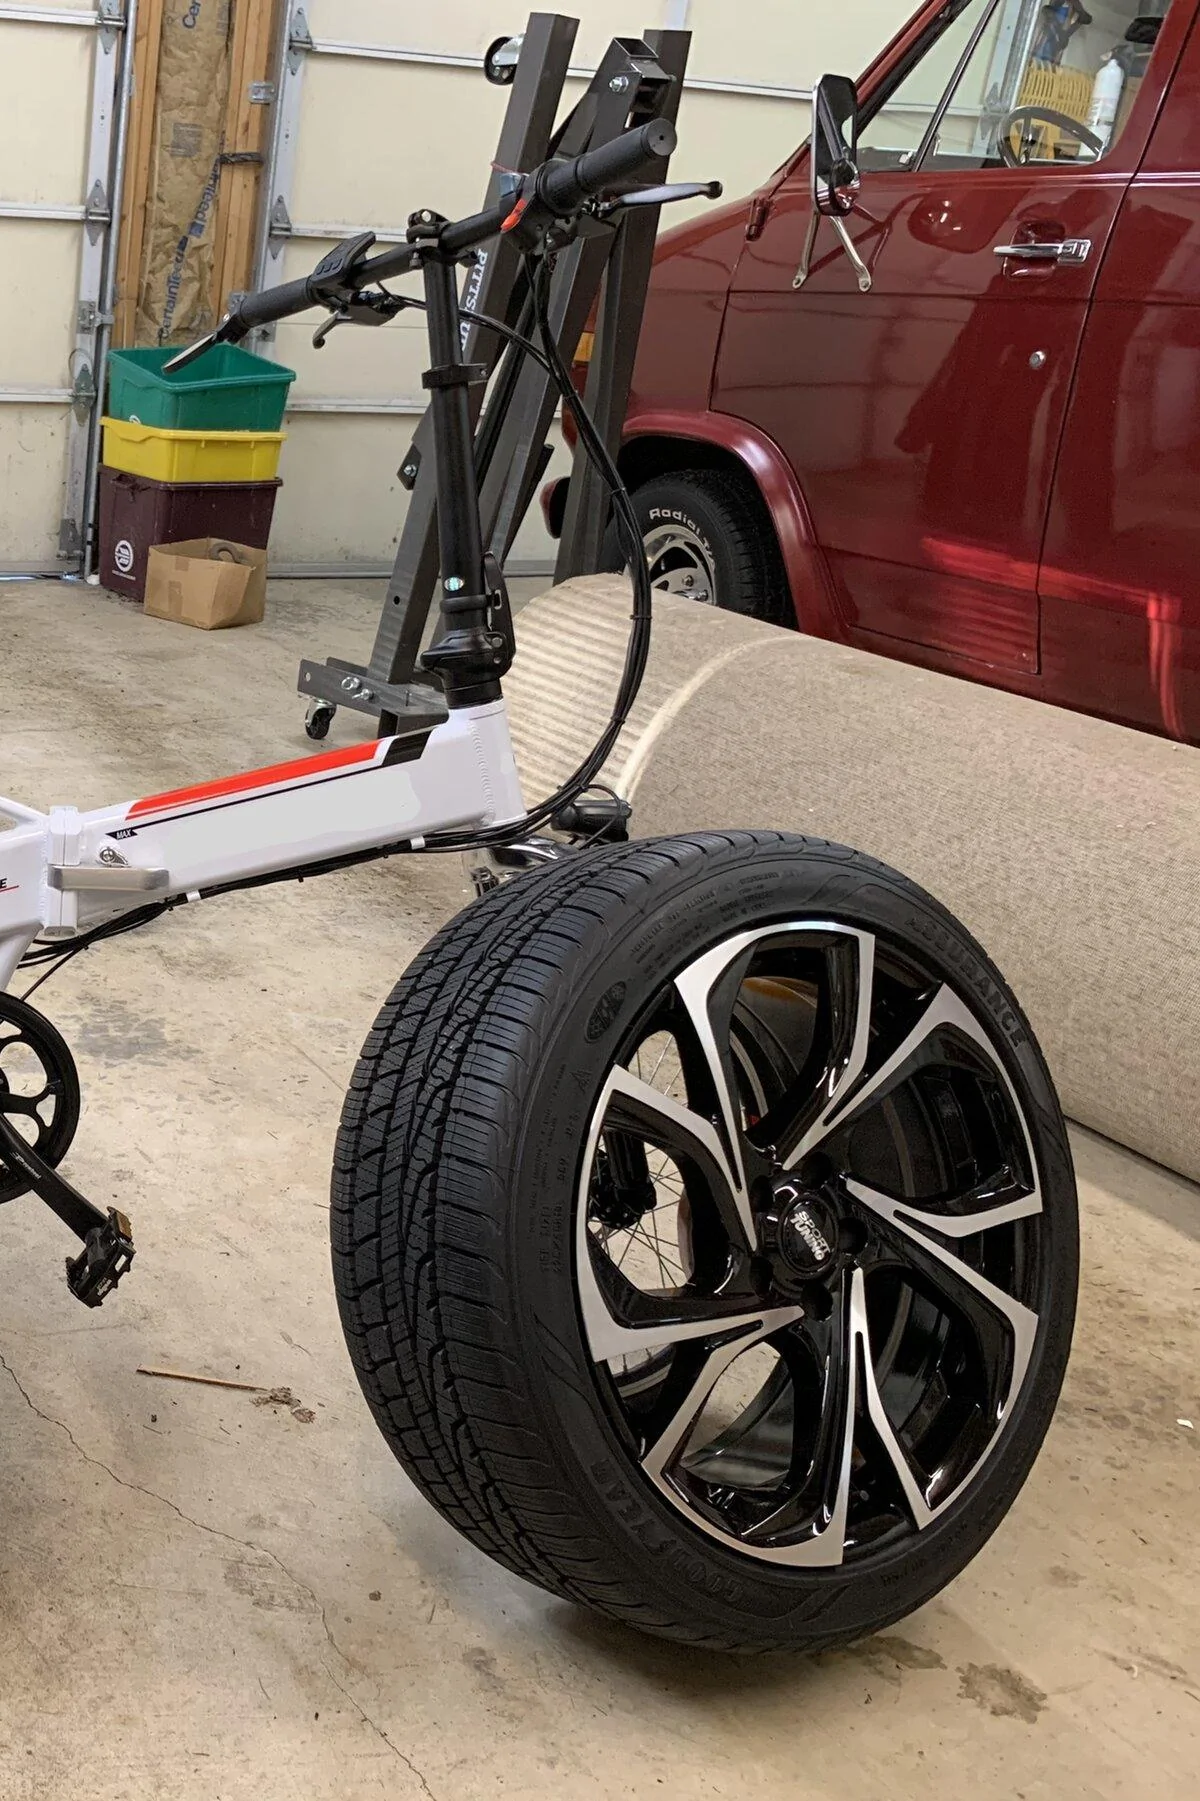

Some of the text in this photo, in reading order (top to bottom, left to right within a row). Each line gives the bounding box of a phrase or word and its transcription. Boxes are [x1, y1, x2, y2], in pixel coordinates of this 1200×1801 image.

[649, 508, 700, 535] Radial
[116, 829, 132, 840] MAX
[904, 918, 1026, 1048] ASSURANCE
[789, 1213, 825, 1261] TUNING
[798, 1211, 831, 1253] SPORT
[589, 1457, 744, 1602] GOODYEAR
